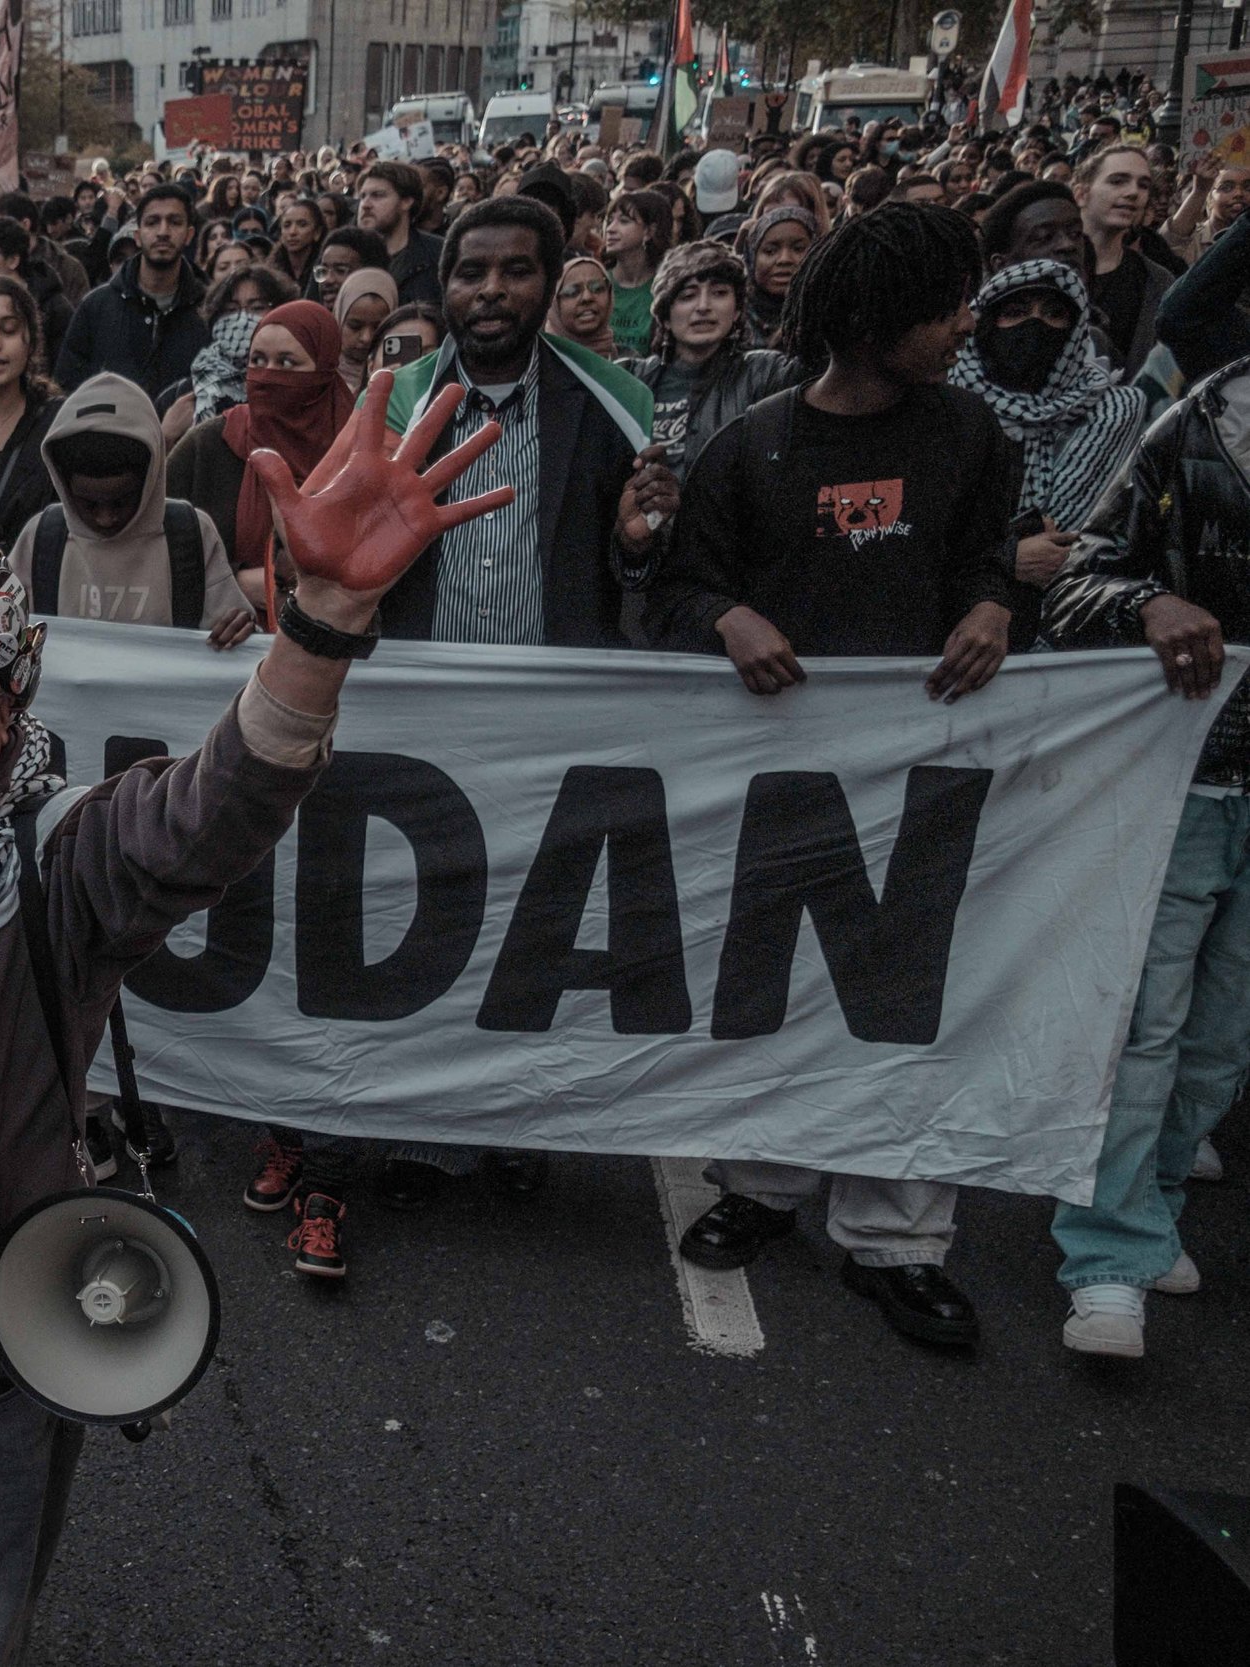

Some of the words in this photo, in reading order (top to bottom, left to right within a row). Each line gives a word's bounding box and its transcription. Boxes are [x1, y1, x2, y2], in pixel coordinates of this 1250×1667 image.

[203, 65, 294, 83] WOMEN
[232, 103, 291, 118] OBAL
[231, 117, 298, 133] OMEN'S
[78, 583, 150, 622] 1977
[49, 730, 994, 1046] UDAN
